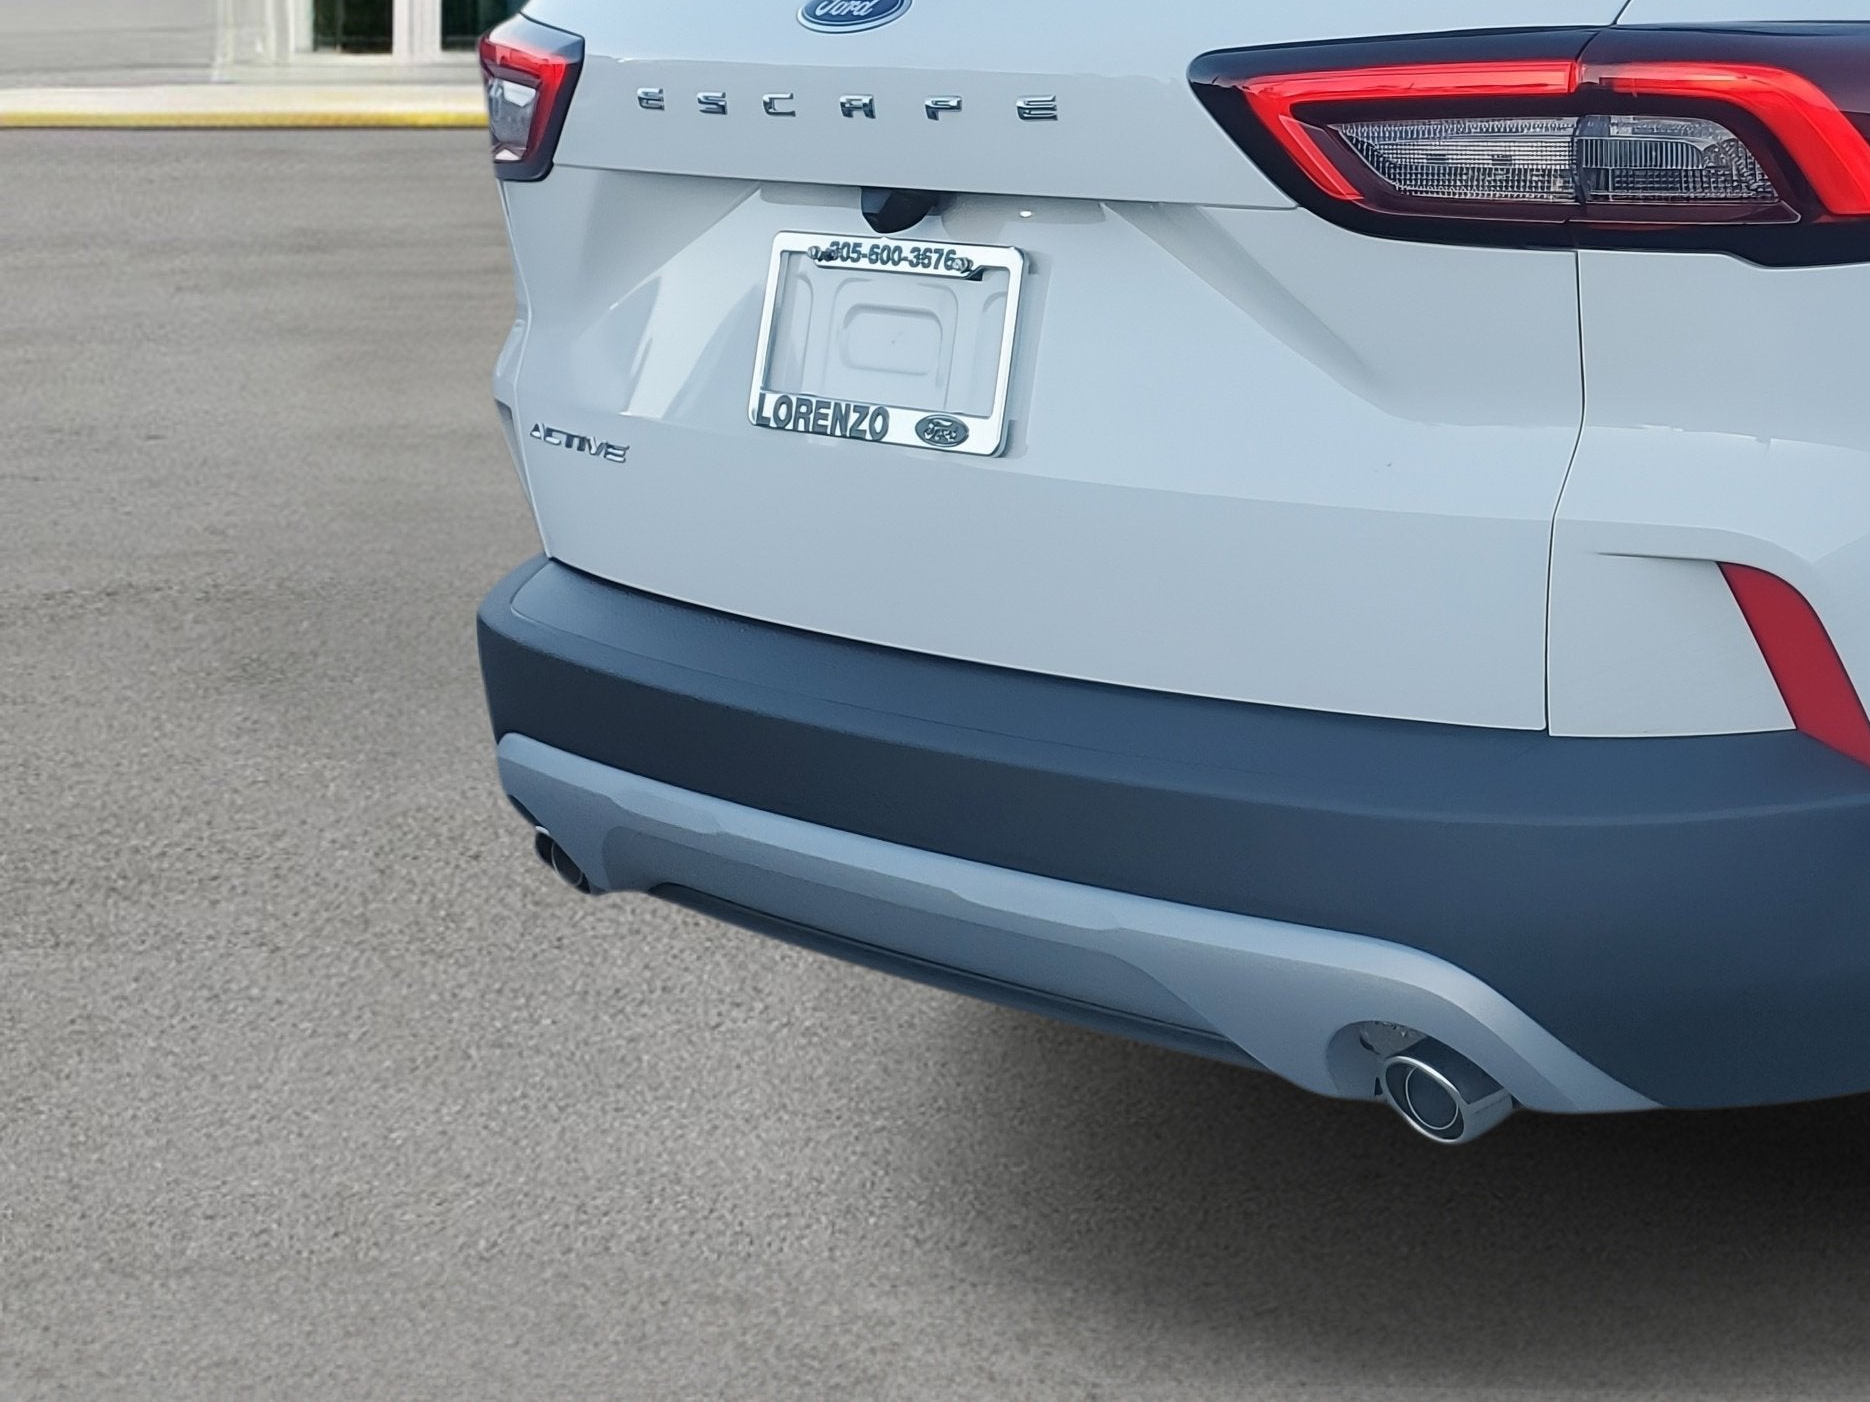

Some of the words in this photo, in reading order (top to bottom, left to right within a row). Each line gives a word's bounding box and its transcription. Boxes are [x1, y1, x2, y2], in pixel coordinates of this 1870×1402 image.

[636, 87, 1058, 122] ESCAPE
[755, 392, 889, 442] LORENZO
[529, 422, 630, 464] ACTIVE
